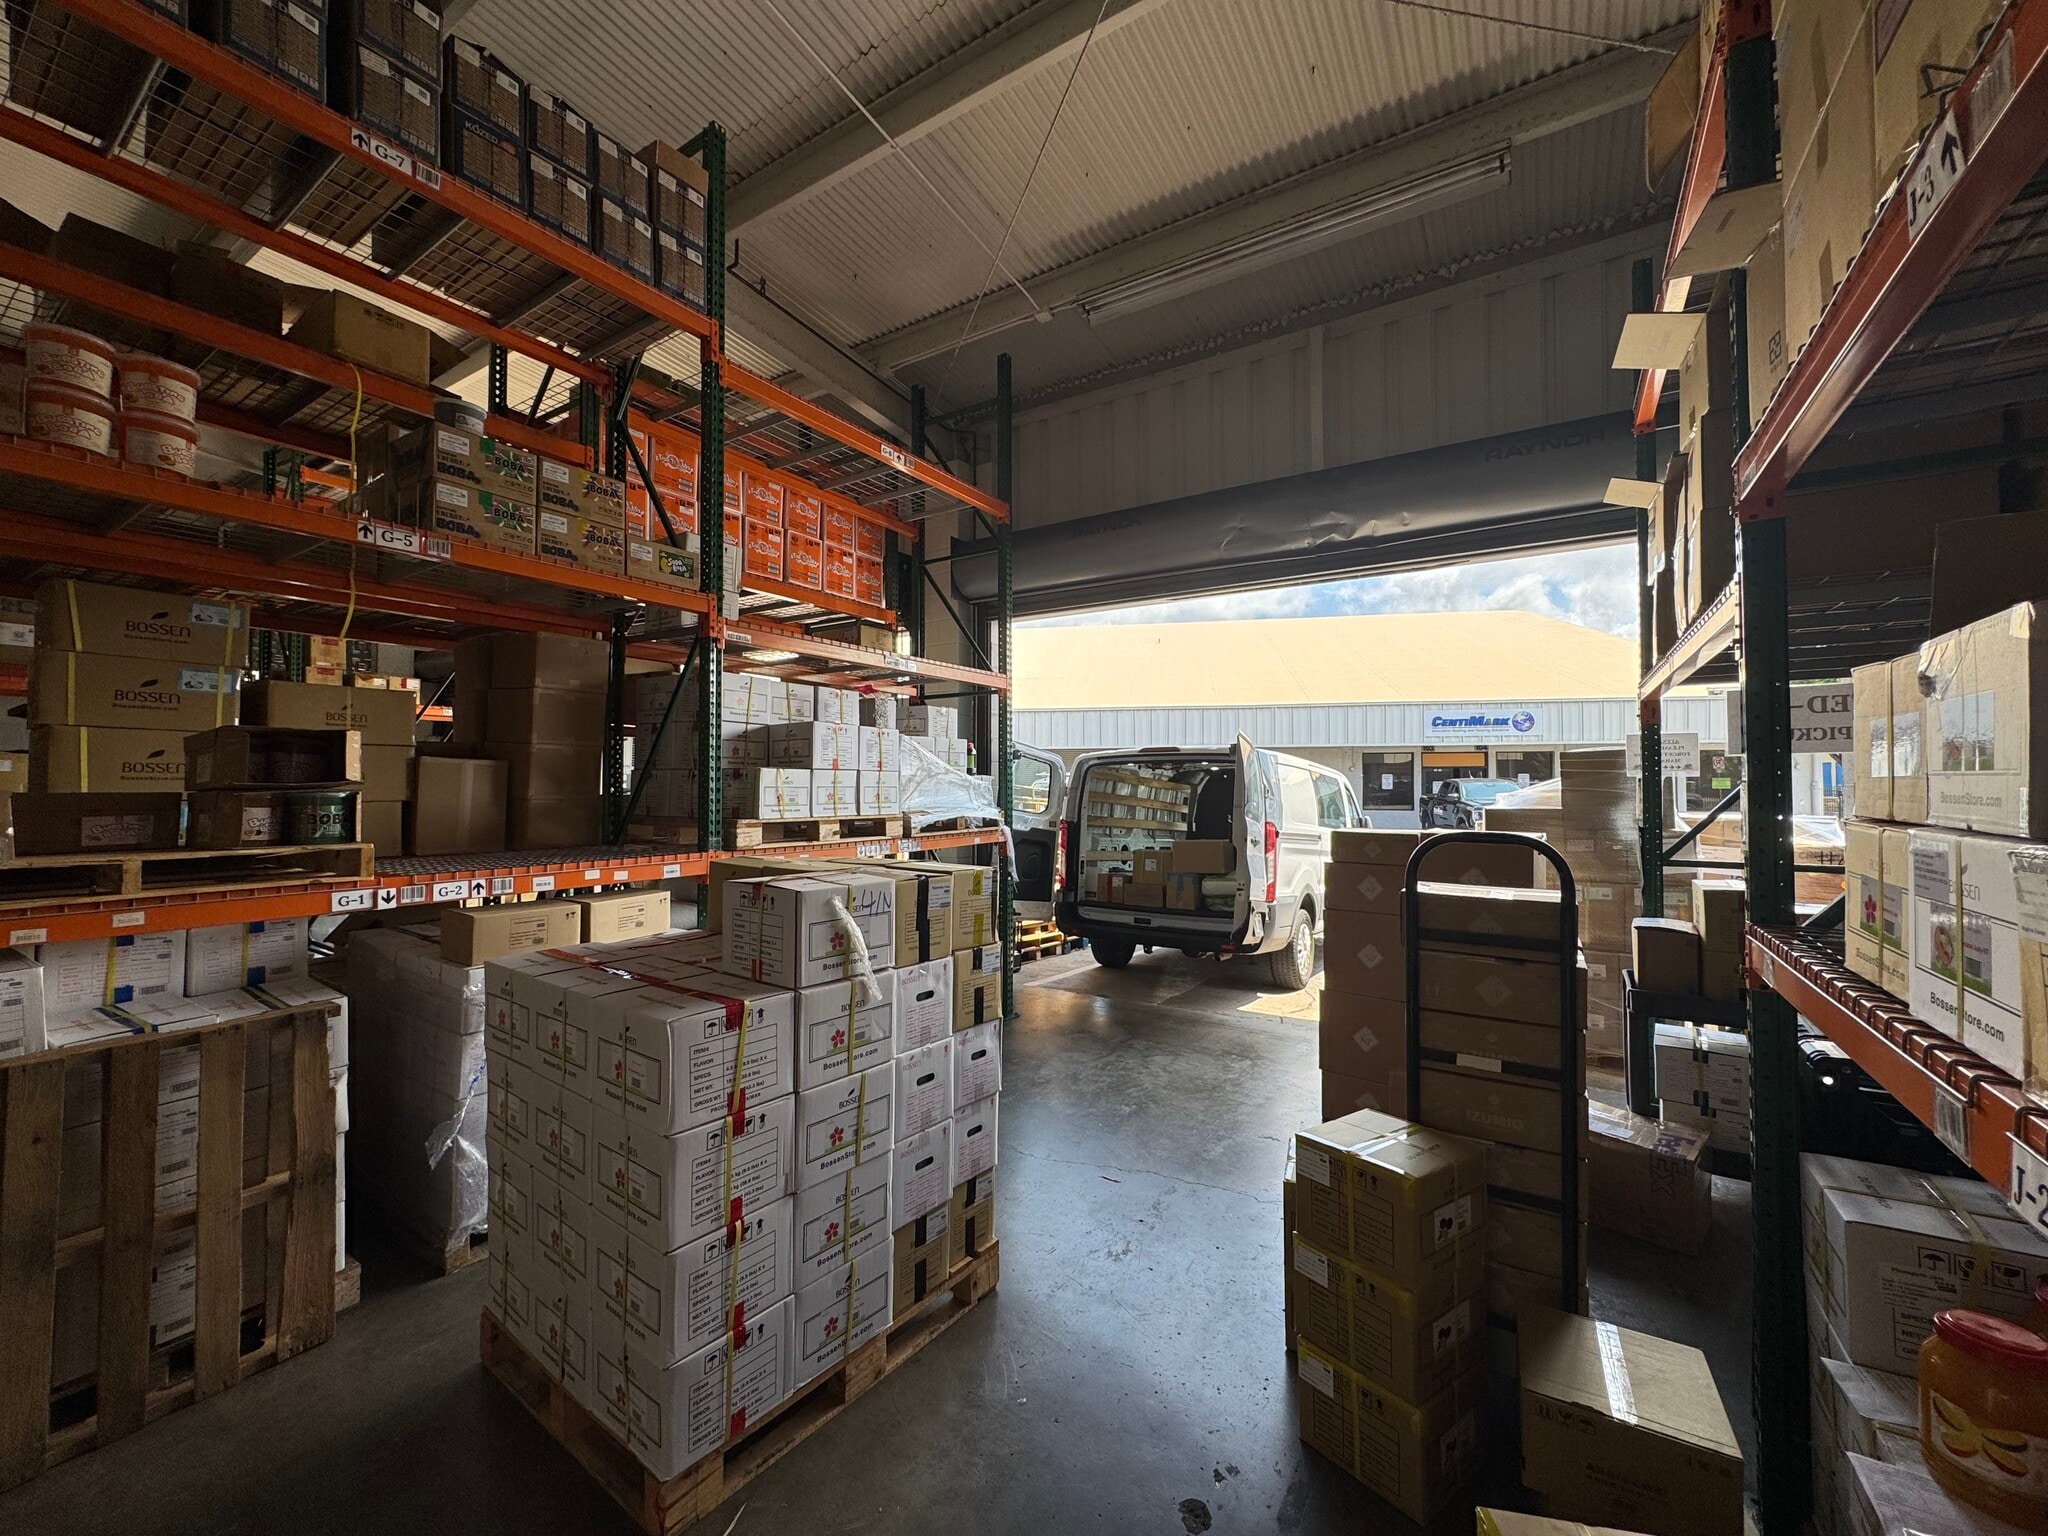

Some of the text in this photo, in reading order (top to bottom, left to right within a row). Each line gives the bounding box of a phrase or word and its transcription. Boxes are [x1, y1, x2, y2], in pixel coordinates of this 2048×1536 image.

[375, 144, 406, 168] G-7
[1910, 164, 1934, 227] J-3
[494, 456, 525, 473] BOBA
[590, 484, 616, 498] BOBA
[494, 507, 524, 523] BOBA
[381, 529, 413, 547] G-5
[590, 533, 616, 547] BOBA
[126, 621, 191, 637] BOSSEN
[114, 690, 180, 704] BOSSEN
[438, 884, 463, 898] G-2
[338, 893, 366, 907] G-1
[693, 1058, 714, 1069] FLAVOR
[694, 1071, 711, 1082] SPECS
[694, 1086, 705, 1095] NET
[694, 1096, 713, 1108] GROSS
[695, 1169, 715, 1181] FLAVOR
[695, 1197, 706, 1207] NET
[695, 1209, 713, 1221] GROSS
[692, 1280, 713, 1295] FLAVOR
[692, 1391, 714, 1407] FLAVOR
